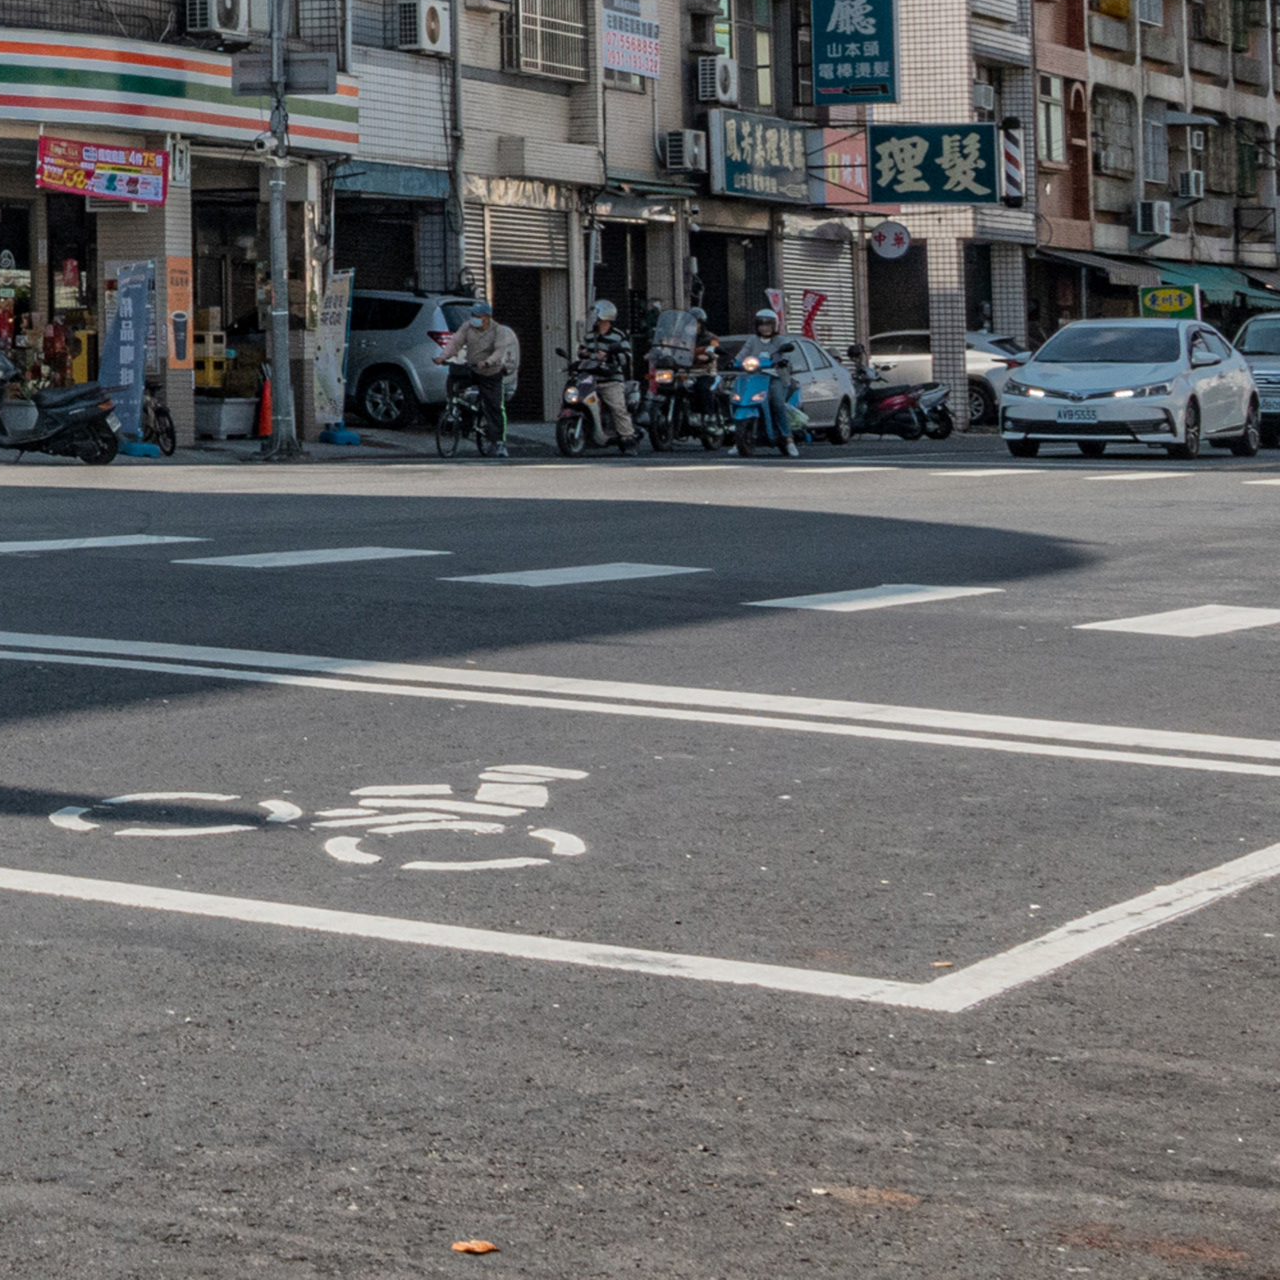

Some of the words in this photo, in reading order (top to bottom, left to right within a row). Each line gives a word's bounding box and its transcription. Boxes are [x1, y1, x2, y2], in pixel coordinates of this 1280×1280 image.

[827, 40, 879, 58] 山本頭
[874, 132, 992, 195] 理髮
